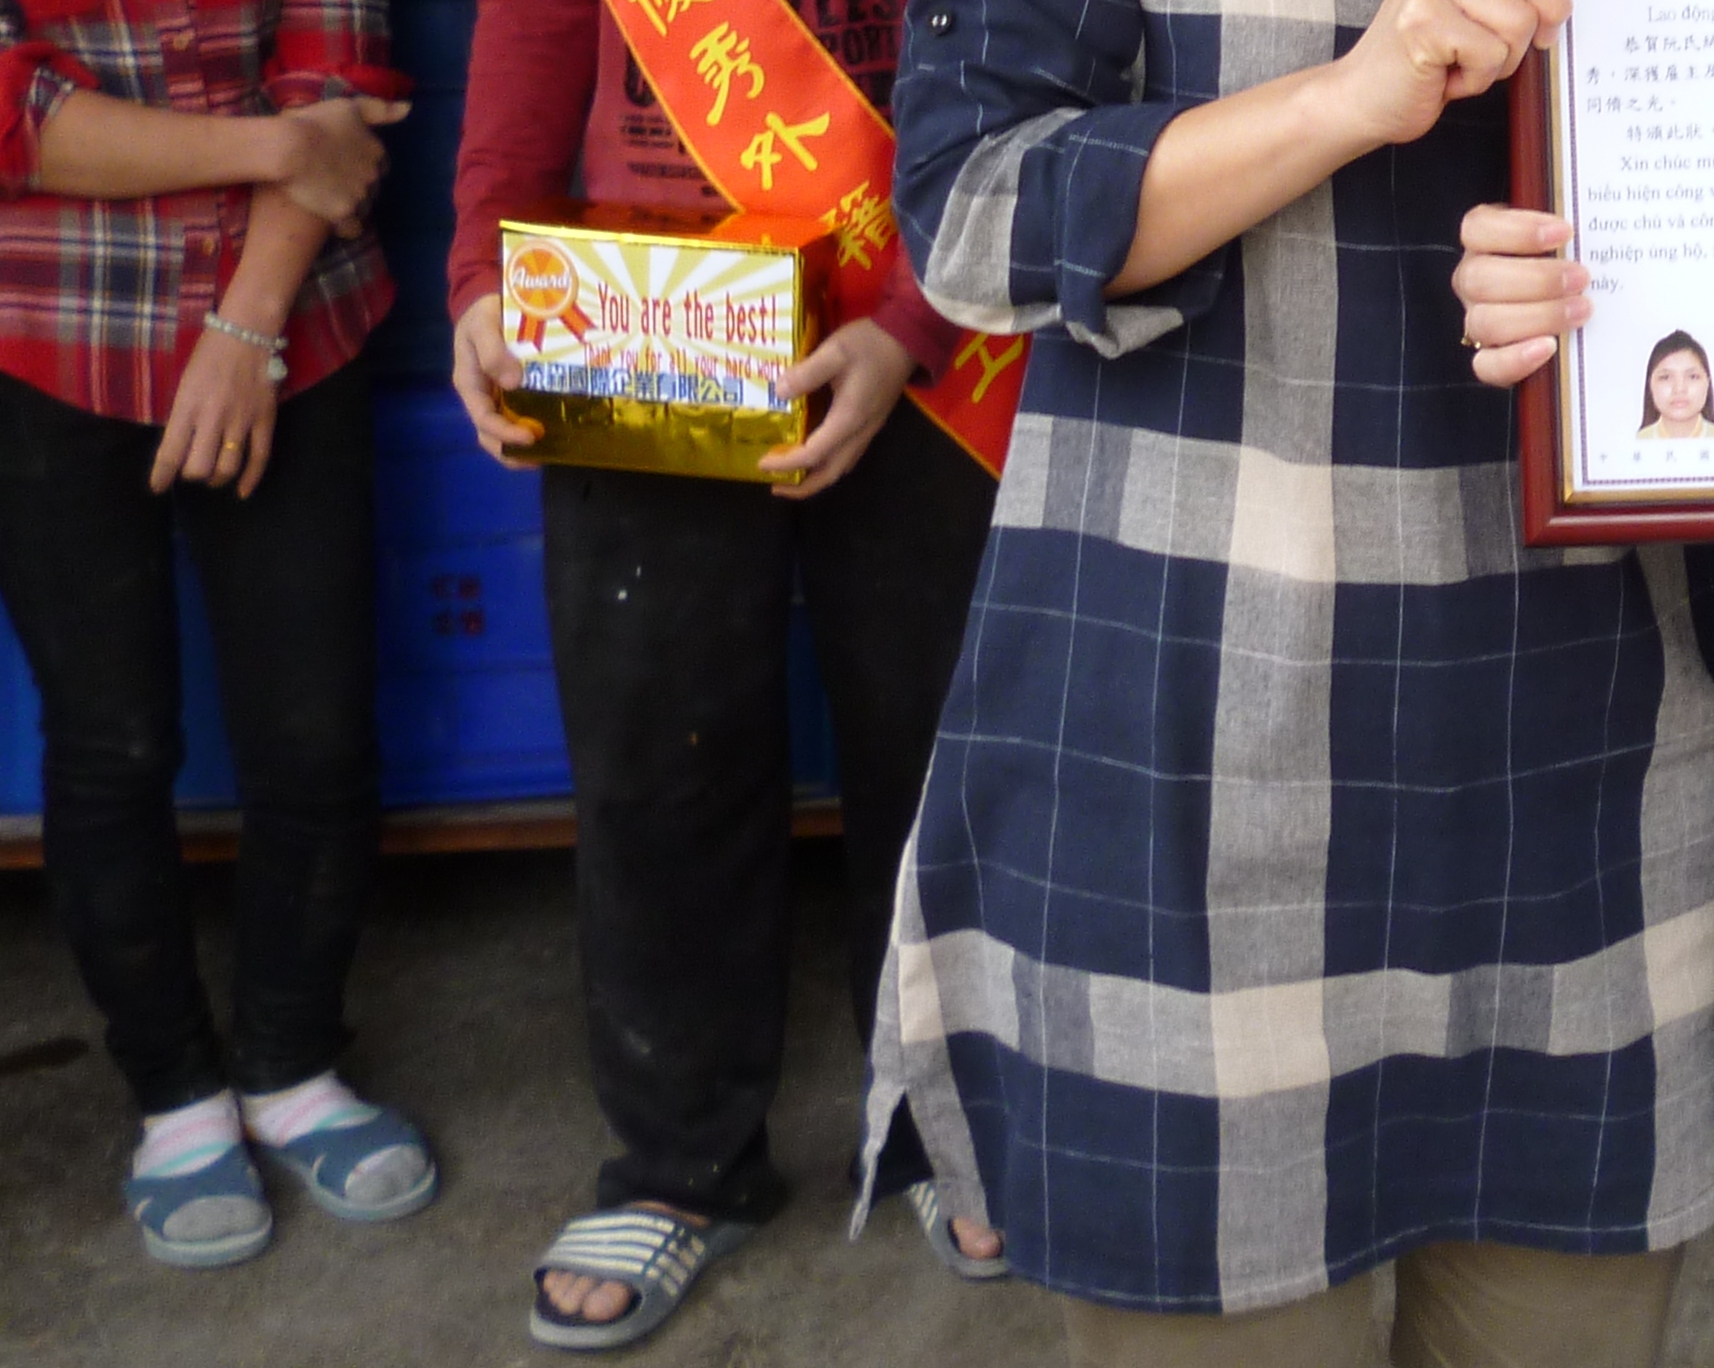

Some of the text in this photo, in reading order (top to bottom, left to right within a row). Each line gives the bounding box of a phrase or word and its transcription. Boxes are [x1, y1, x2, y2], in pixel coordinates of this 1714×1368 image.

[1648, 6, 1676, 22] Lao
[1621, 155, 1649, 171] Xin
[1654, 153, 1691, 171] chúc
[1627, 184, 1660, 204] hiện
[1666, 184, 1704, 203] công
[1588, 215, 1628, 234] được
[1590, 244, 1644, 265] nghiệp
[511, 266, 571, 290] Award
[598, 281, 777, 345] You are the best!
[584, 342, 611, 369] Thank
[620, 348, 638, 371] you
[645, 346, 662, 373] for
[670, 348, 687, 375] all
[695, 355, 718, 378] your
[725, 352, 751, 379] hard
